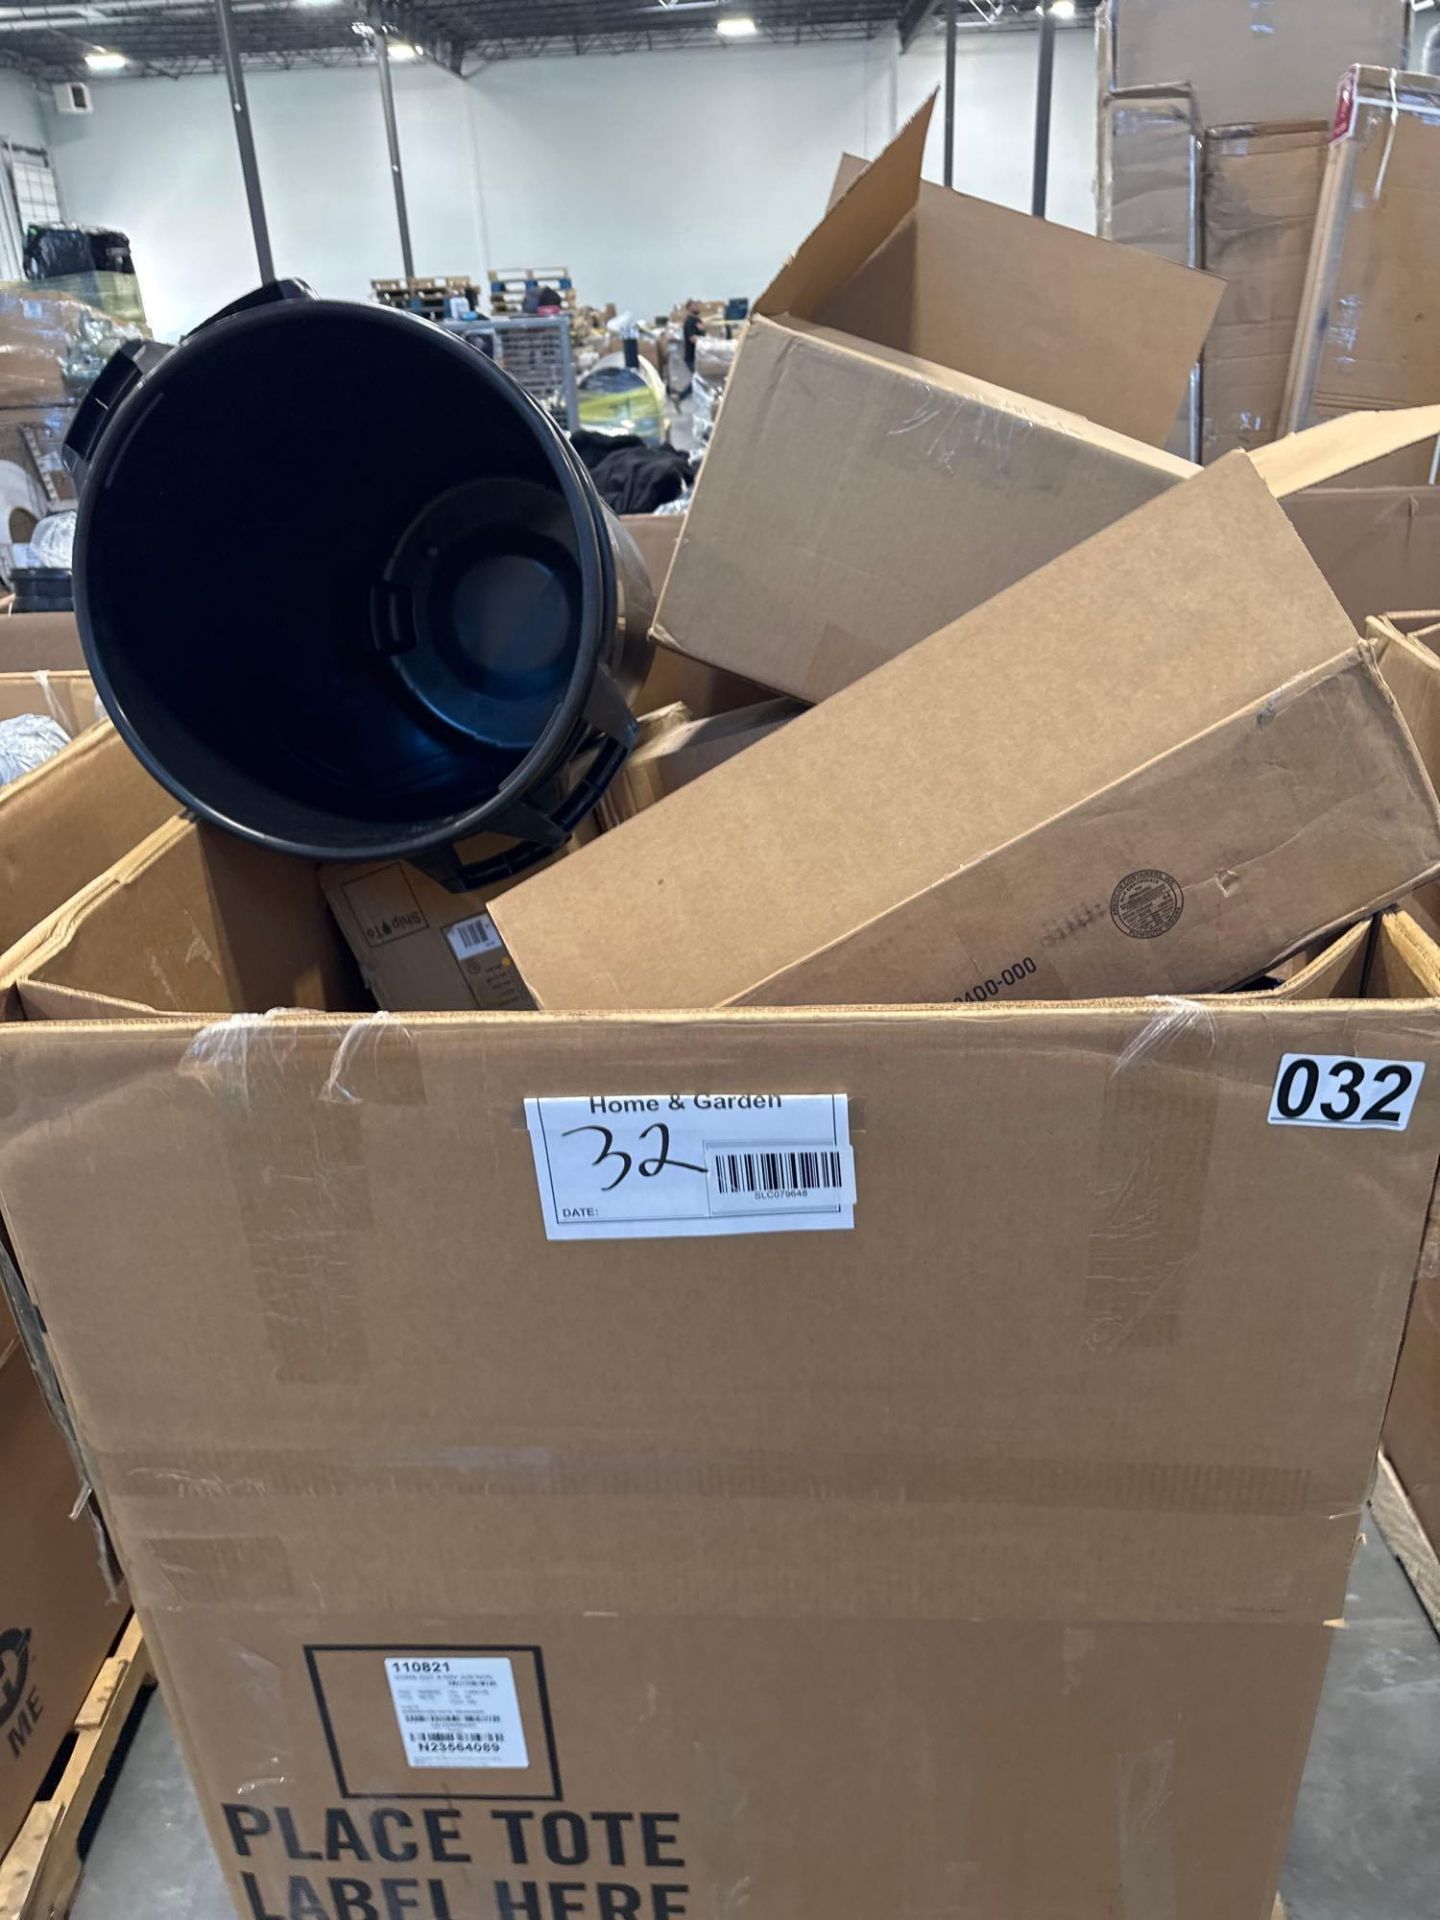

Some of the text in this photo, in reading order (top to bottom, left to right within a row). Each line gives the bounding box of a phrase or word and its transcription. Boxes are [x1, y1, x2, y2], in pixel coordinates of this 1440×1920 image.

[367, 911, 422, 939] Ship To
[590, 1093, 783, 1114] Home & Garden
[1276, 1057, 1413, 1122] 032
[561, 1122, 709, 1191] 32
[392, 1661, 451, 1673] 110821
[221, 1802, 686, 1868] PLACE TOTE
[240, 1870, 690, 1920] LABEL HERE
